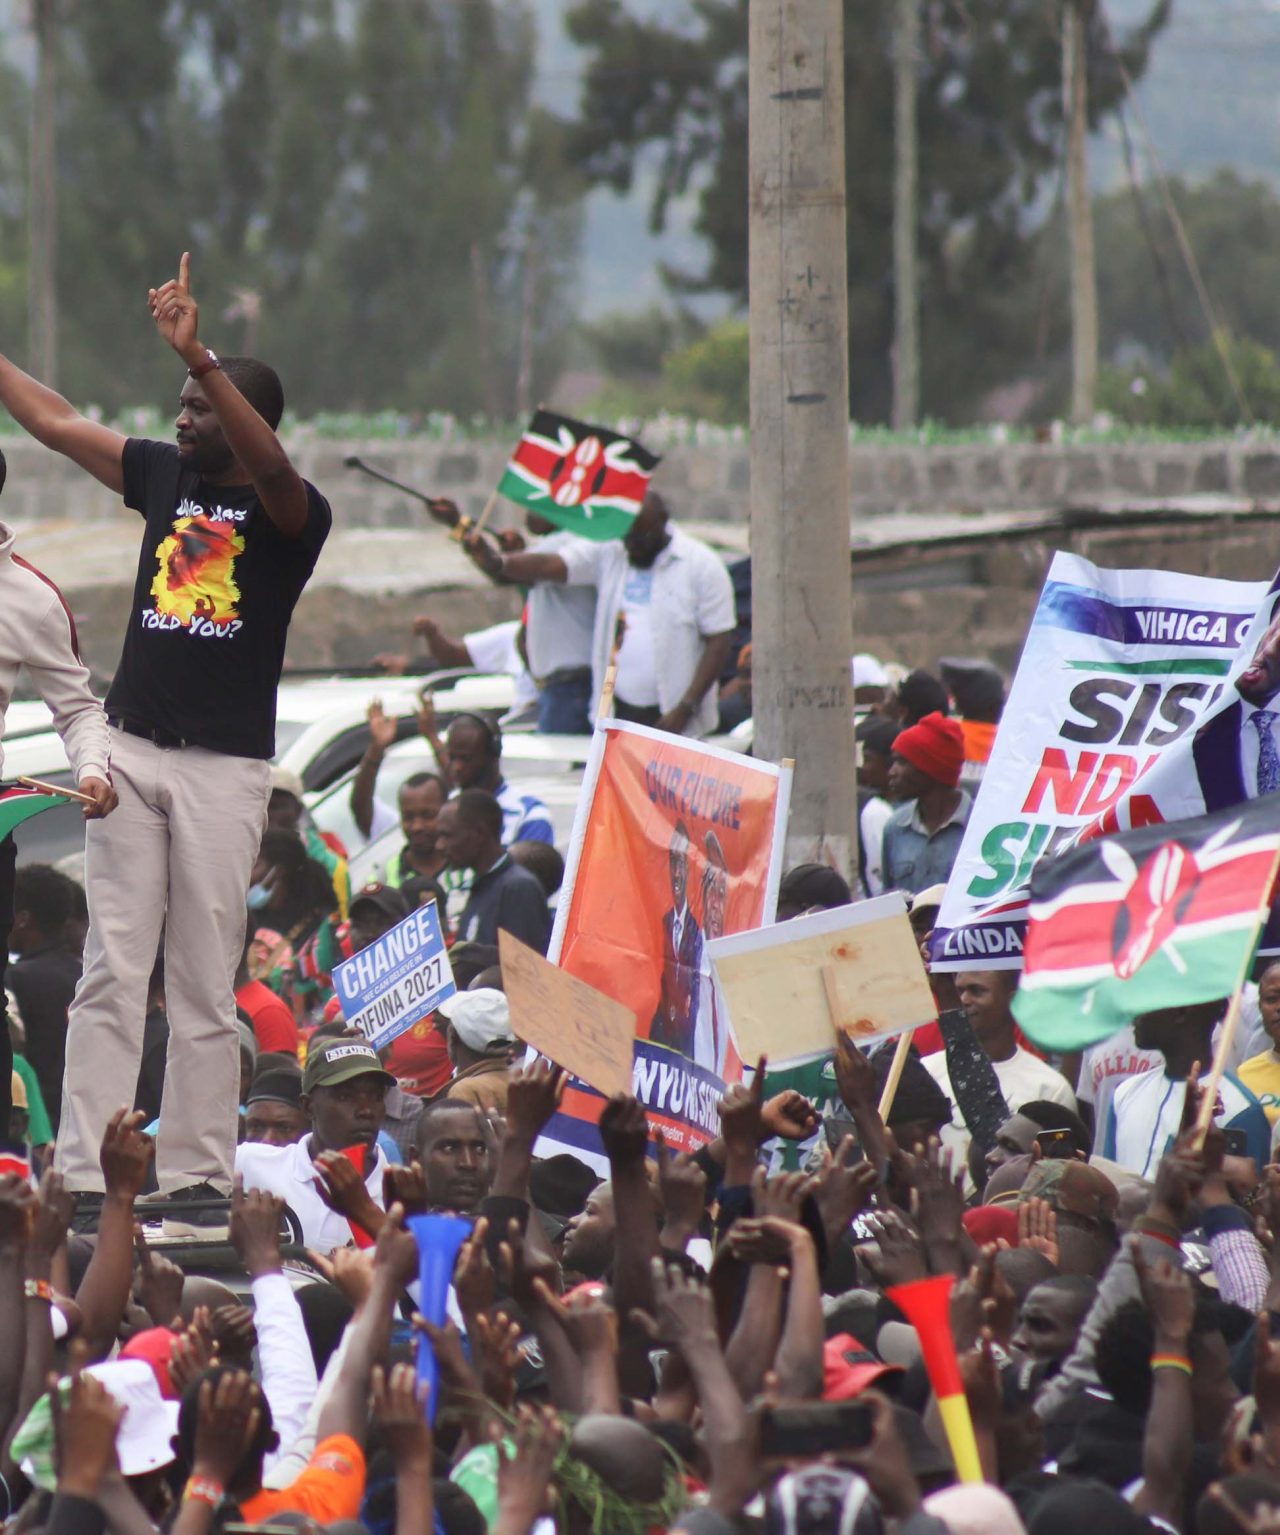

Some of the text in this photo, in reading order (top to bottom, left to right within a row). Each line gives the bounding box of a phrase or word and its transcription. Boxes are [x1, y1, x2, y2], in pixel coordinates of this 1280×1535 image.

[142, 610, 243, 638] TOLD YOU?
[1135, 611, 1227, 642] VIHIGA
[1059, 678, 1224, 747] SIS
[646, 760, 742, 830] OUR FUTURE
[340, 908, 434, 999] CHANGE
[944, 927, 1024, 956] LINDA
[354, 958, 442, 1039] SIFUNA 2027
[362, 990, 374, 1003] WE
[374, 980, 391, 997] CAN
[414, 953, 423, 966] IN
